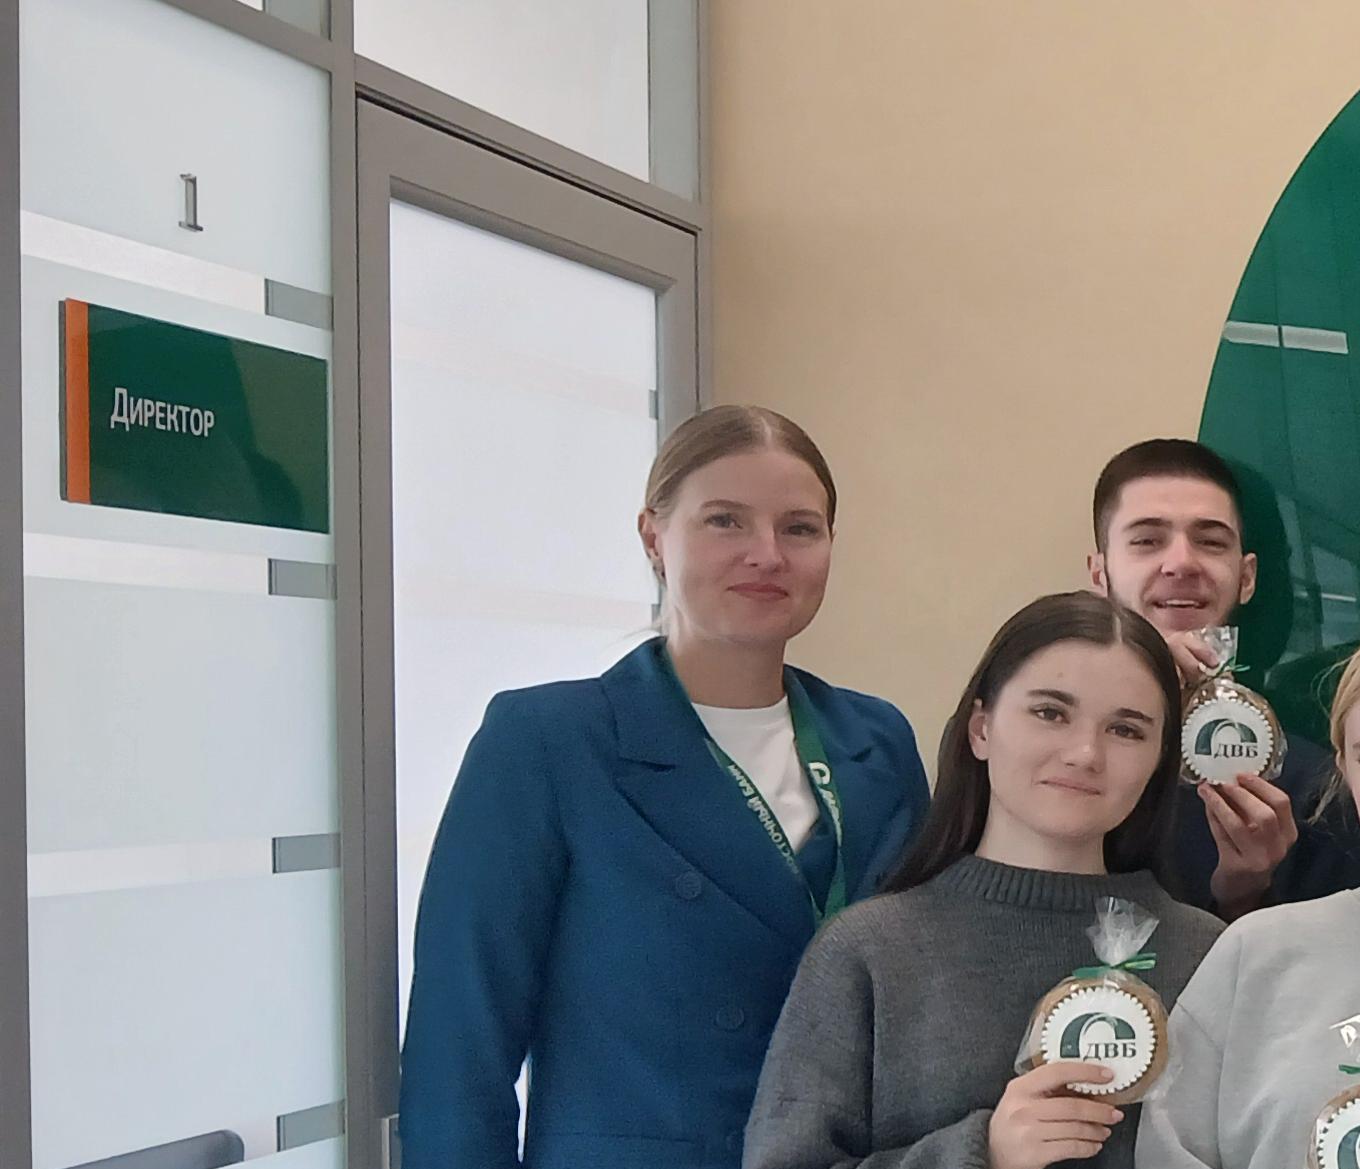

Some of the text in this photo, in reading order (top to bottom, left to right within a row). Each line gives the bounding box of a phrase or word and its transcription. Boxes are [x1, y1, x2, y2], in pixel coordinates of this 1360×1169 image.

[178, 173, 203, 232] 1
[1213, 738, 1259, 760] ДВБ
[1083, 1041, 1137, 1061] ДВБ
